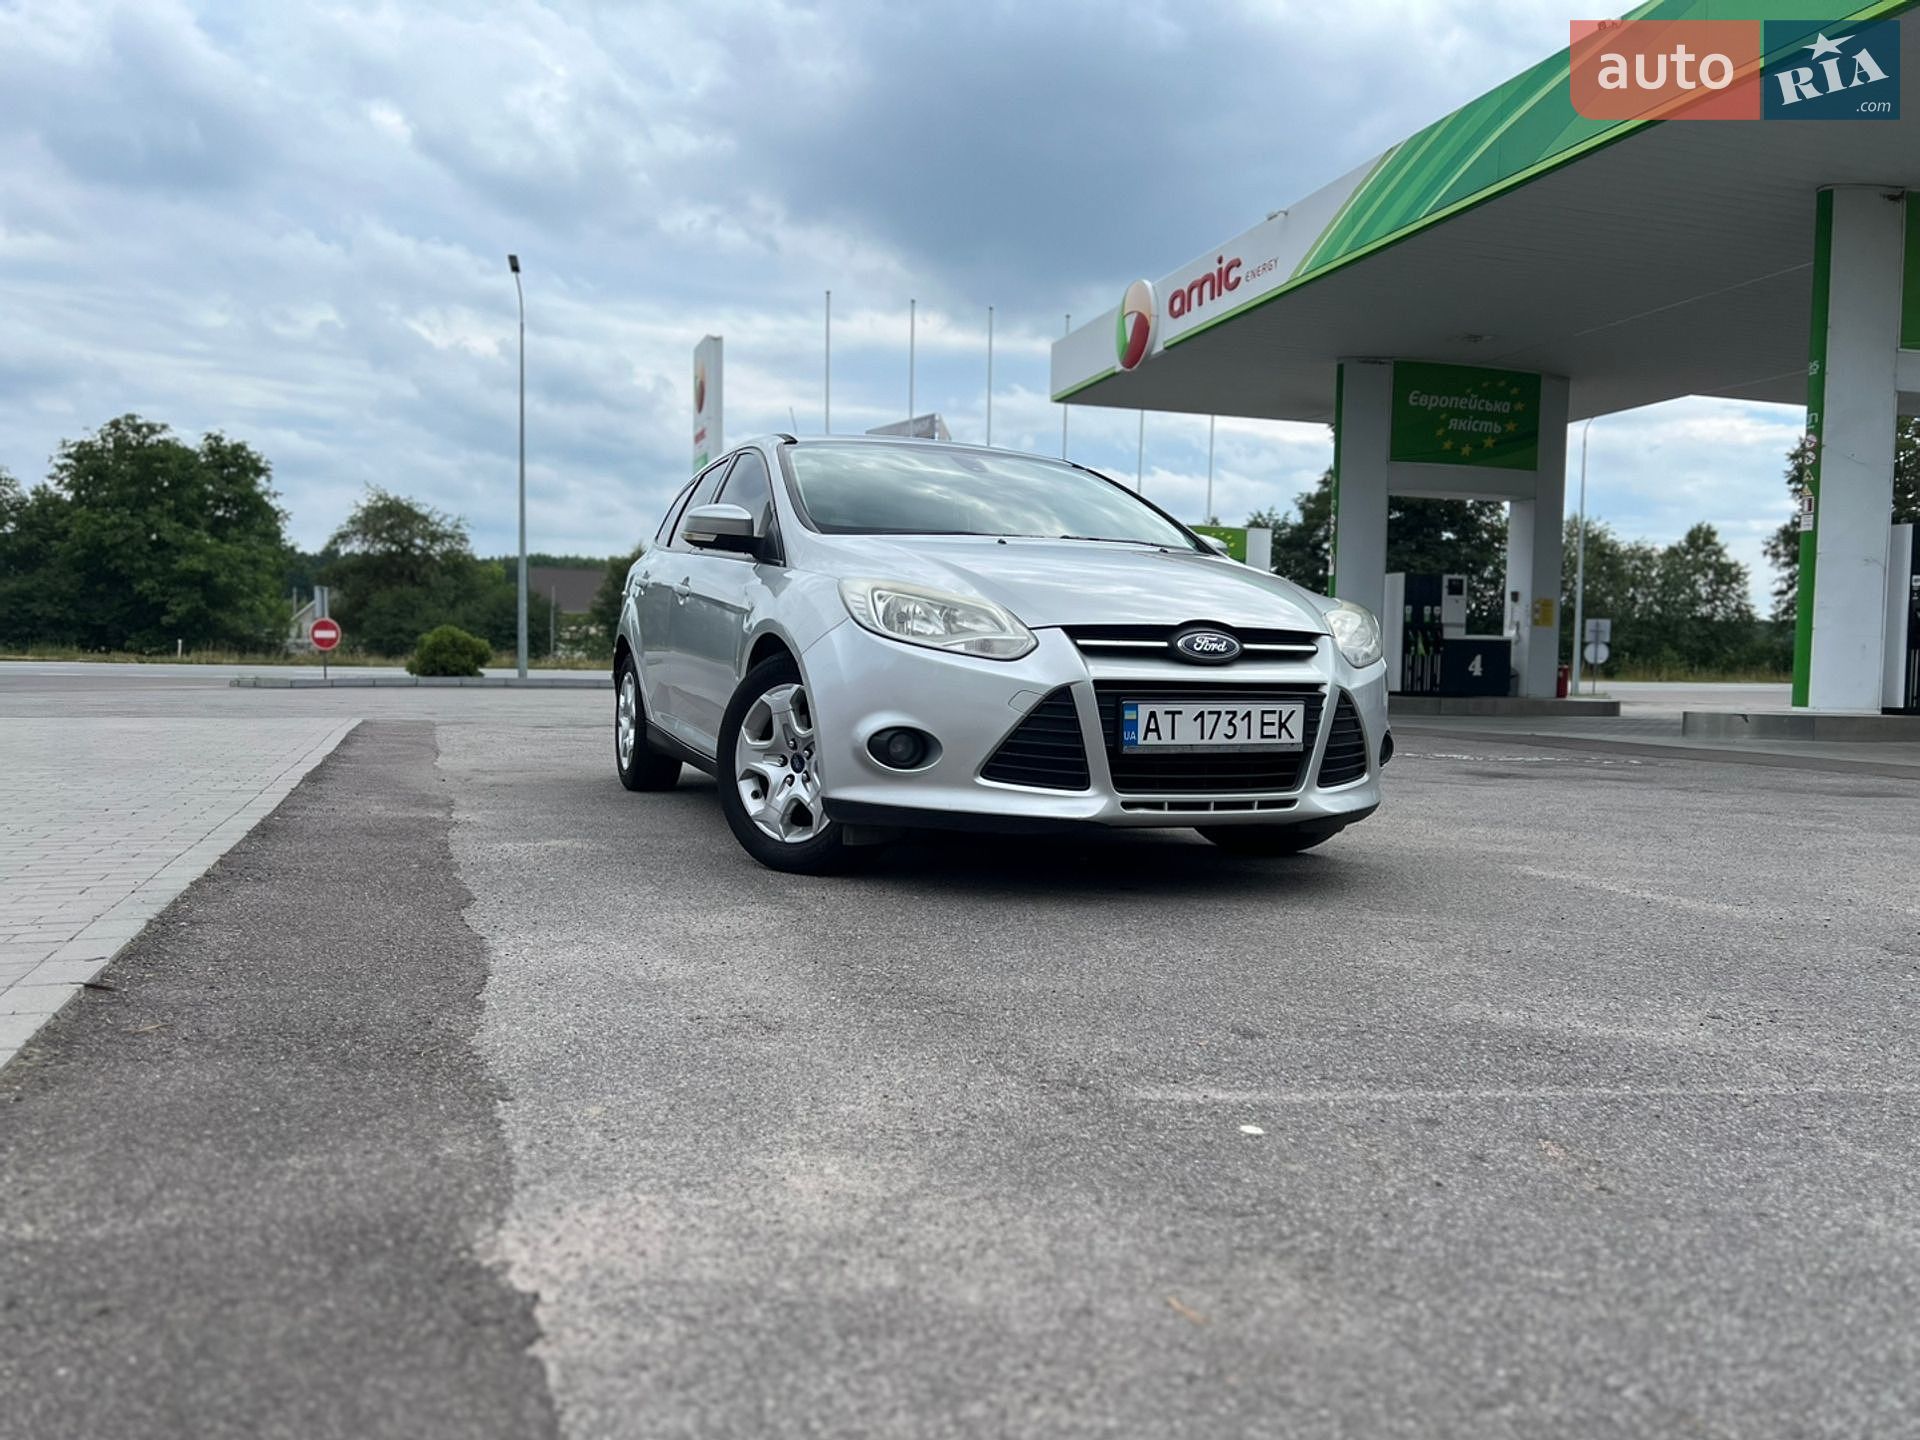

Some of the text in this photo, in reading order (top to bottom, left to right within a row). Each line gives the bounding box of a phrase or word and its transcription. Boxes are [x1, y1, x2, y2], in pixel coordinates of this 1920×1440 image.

[1168, 254, 1280, 319] amic ENERGY
[1408, 389, 1512, 414] Європейська
[1447, 414, 1503, 434] якість
[1193, 635, 1228, 653] Ford
[1467, 653, 1483, 677] 4
[1123, 730, 1138, 742] UA
[1142, 710, 1183, 741] AT
